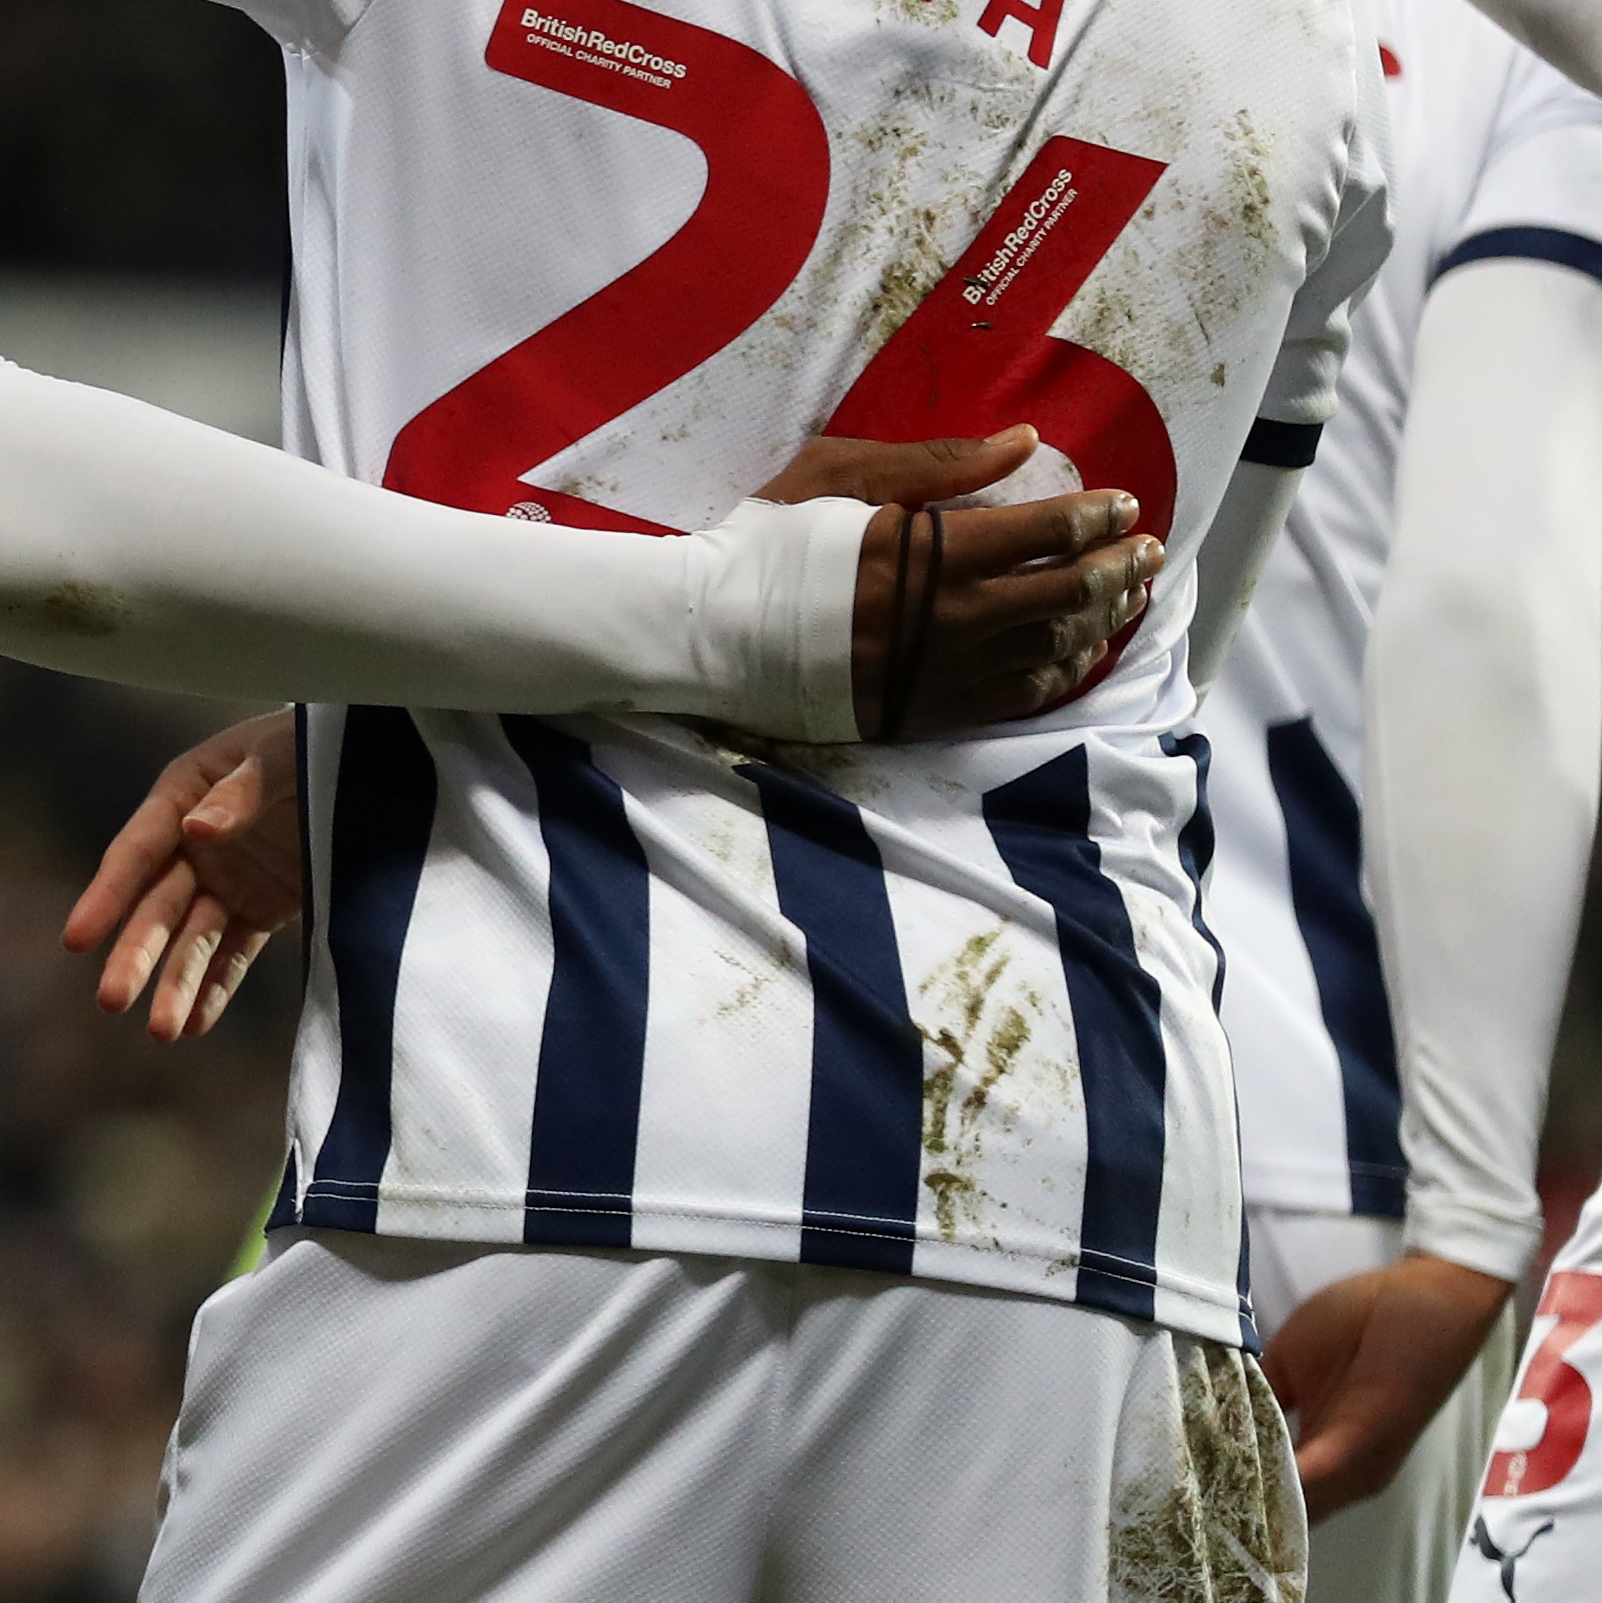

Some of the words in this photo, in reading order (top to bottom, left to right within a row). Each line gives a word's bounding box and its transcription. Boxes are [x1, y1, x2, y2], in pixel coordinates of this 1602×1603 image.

[520, 7, 688, 79] BritishRedCross
[526, 32, 574, 58] OFFICIAL
[574, 49, 623, 73] CHARITY
[622, 65, 673, 90] PARTNER
[985, 266, 1021, 307] OFFICIAL
[1015, 227, 1048, 268] CHARITY
[1043, 188, 1079, 231] PARTNER
